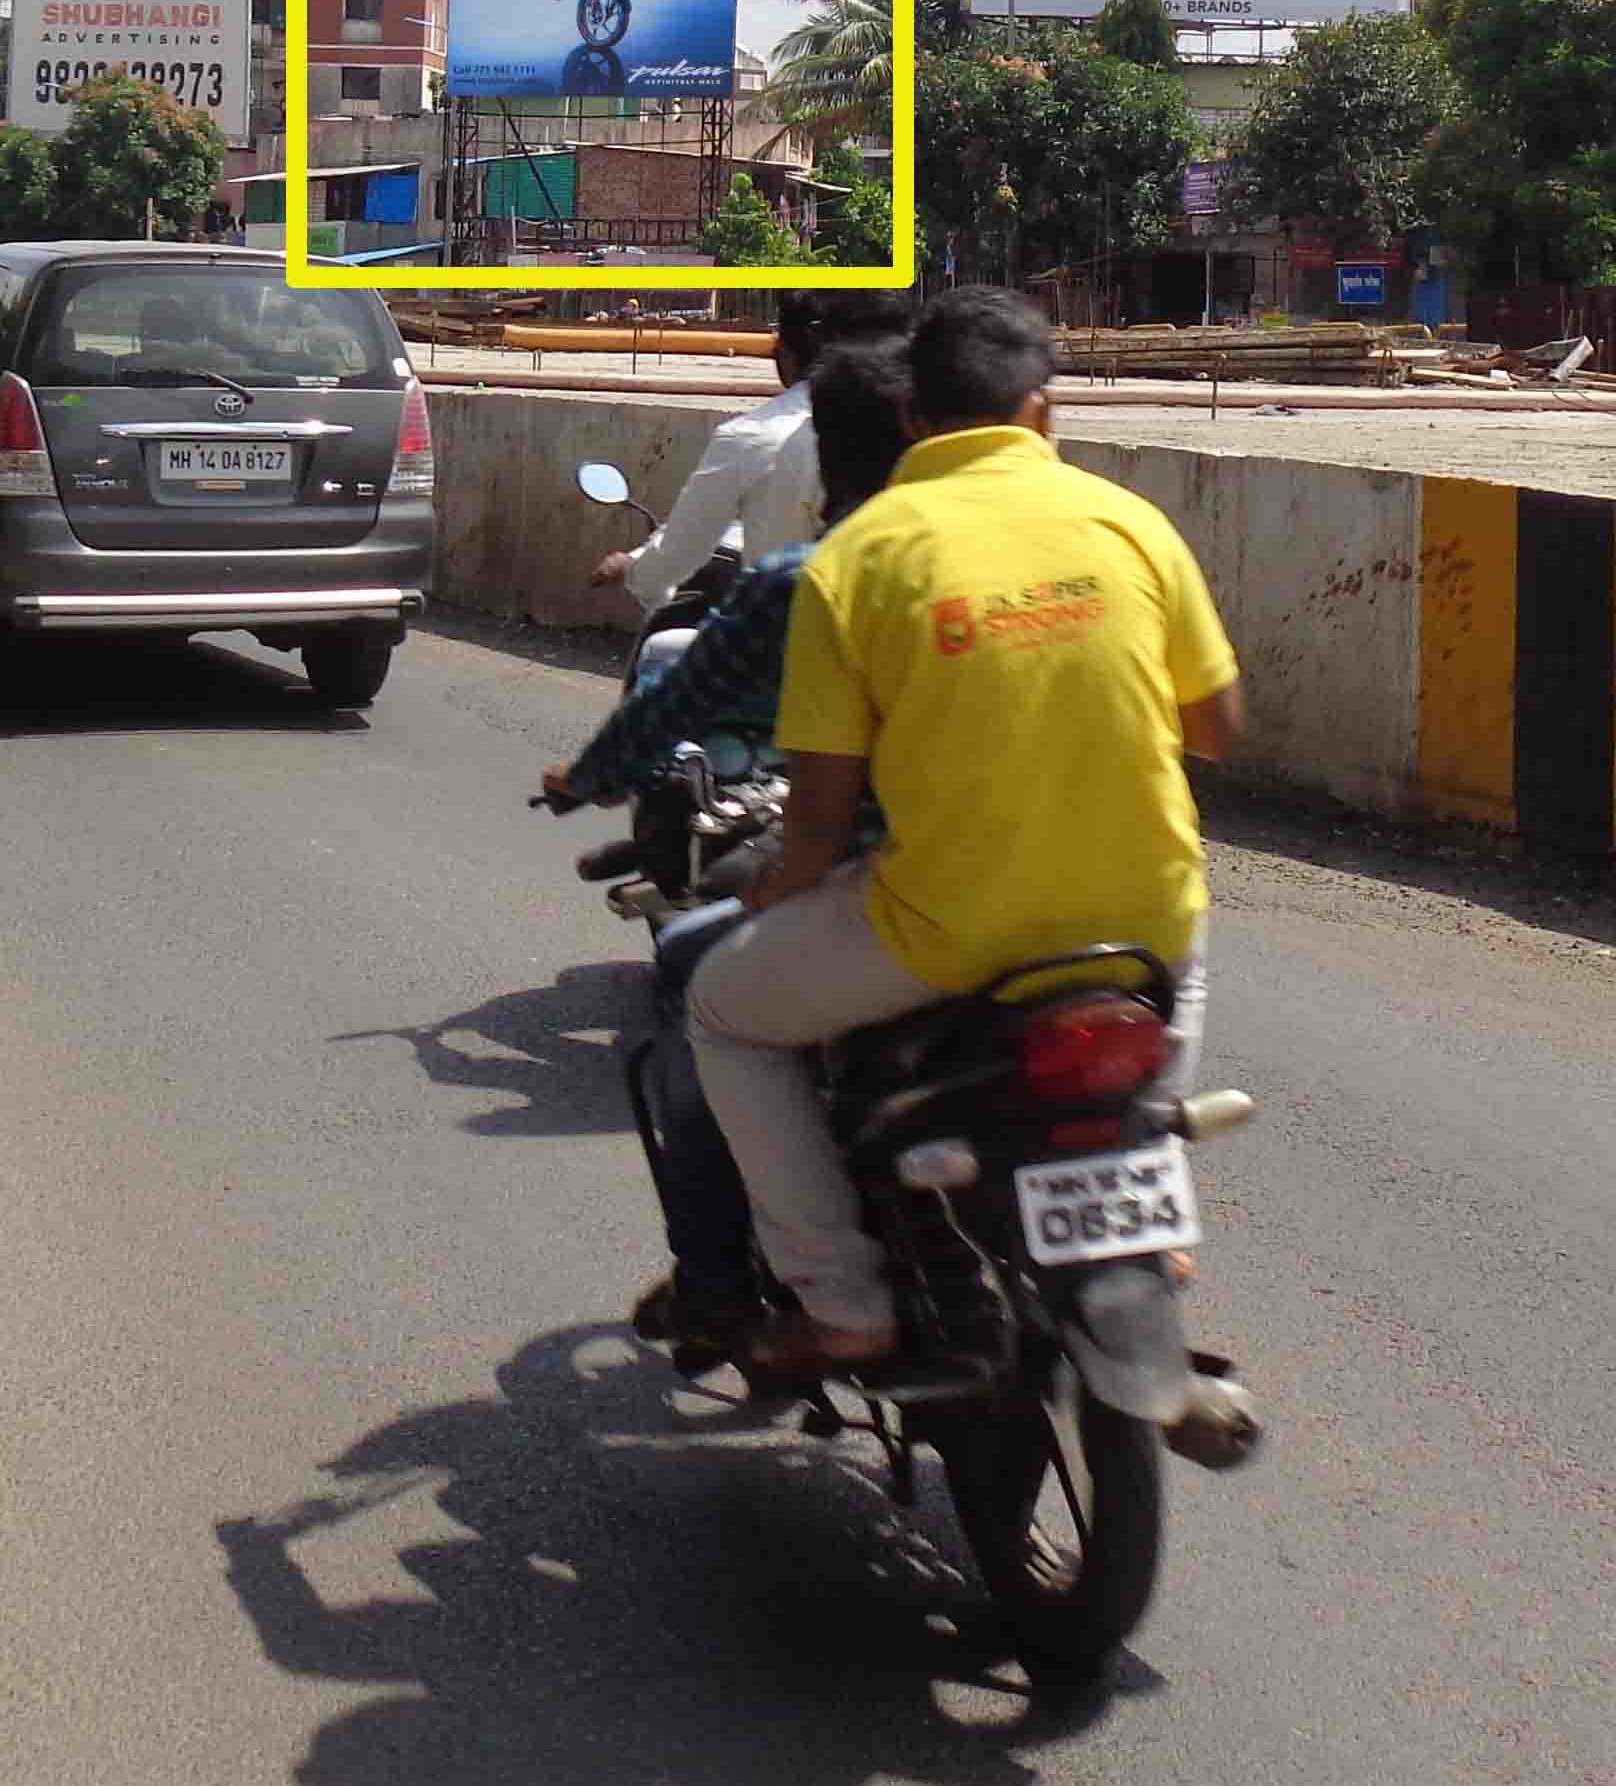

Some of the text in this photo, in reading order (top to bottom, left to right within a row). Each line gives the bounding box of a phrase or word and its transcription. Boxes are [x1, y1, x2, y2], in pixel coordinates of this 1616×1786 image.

[41, 3, 221, 28] SHUBHANGI
[1187, 0, 1253, 14] BRANDS
[40, 32, 221, 45] ADVERTISING
[169, 450, 191, 470] MH
[199, 450, 215, 470] 14
[246, 451, 287, 471] 8127
